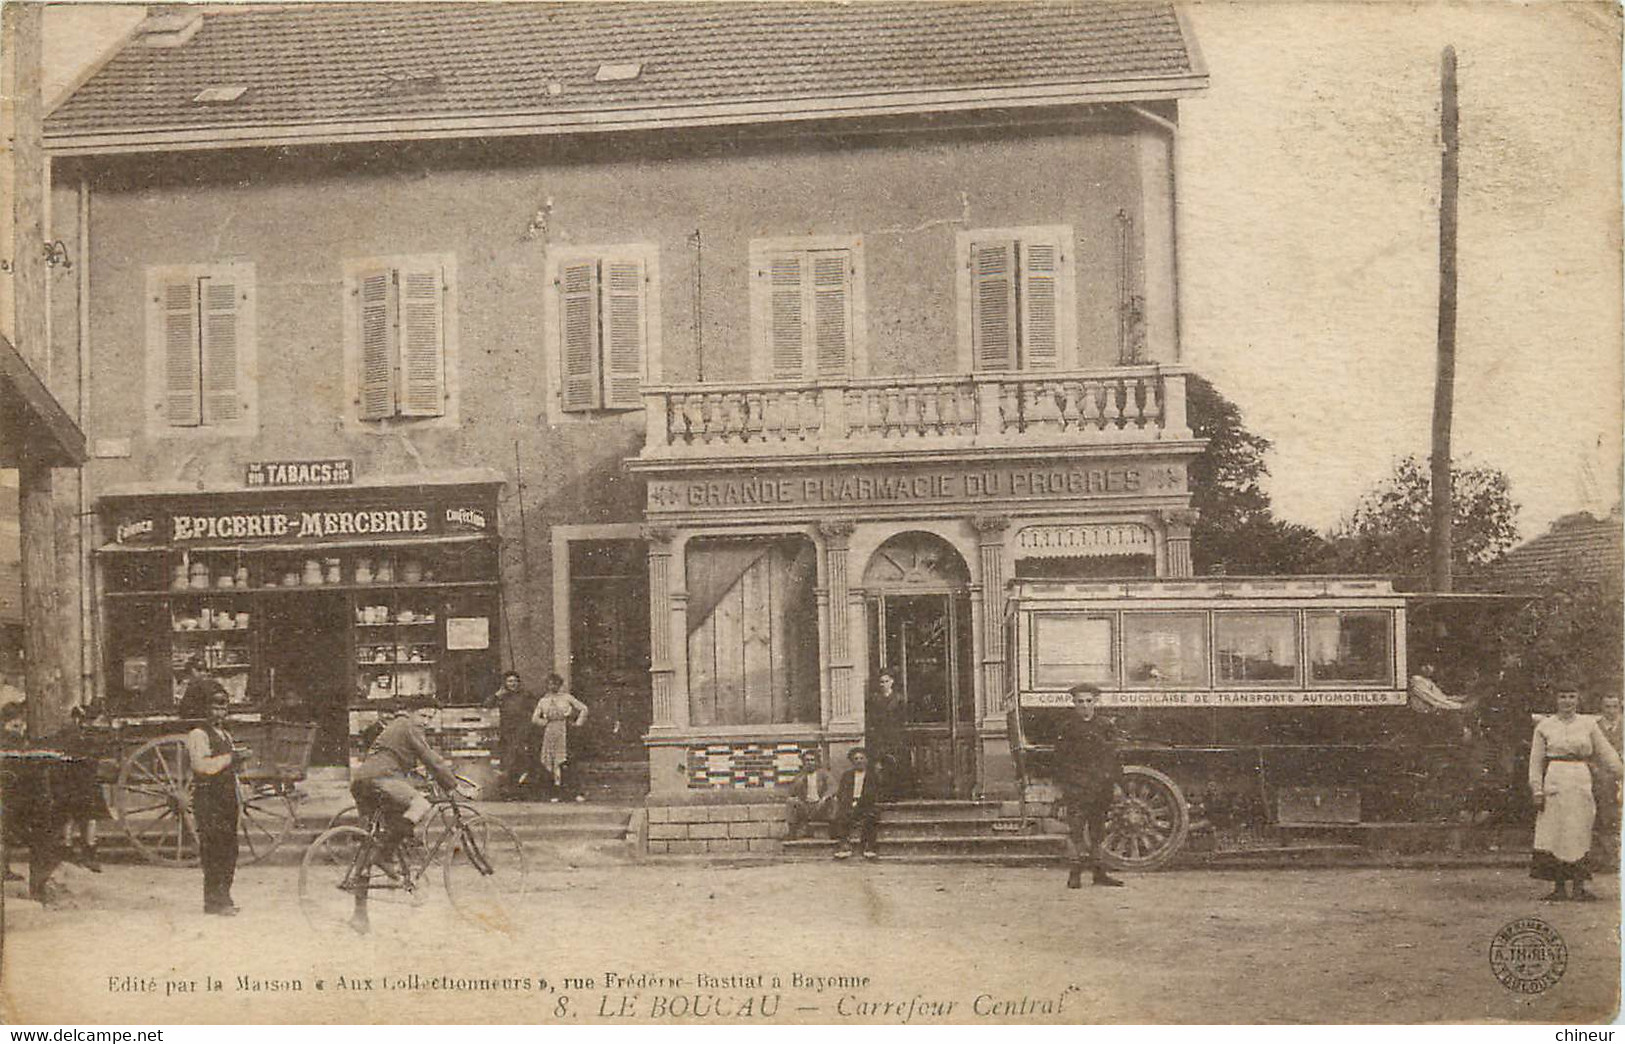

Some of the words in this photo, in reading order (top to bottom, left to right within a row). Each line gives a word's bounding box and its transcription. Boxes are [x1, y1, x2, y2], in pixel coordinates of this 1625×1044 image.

[266, 463, 333, 483] TABACS
[687, 481, 793, 506] GRANDE
[802, 475, 954, 502] PHARMACIE
[965, 473, 999, 497] DU
[1193, 692, 1208, 703] DE
[1217, 692, 1294, 704] TRANSPORTS
[1302, 691, 1388, 703] AUTOMOBILES
